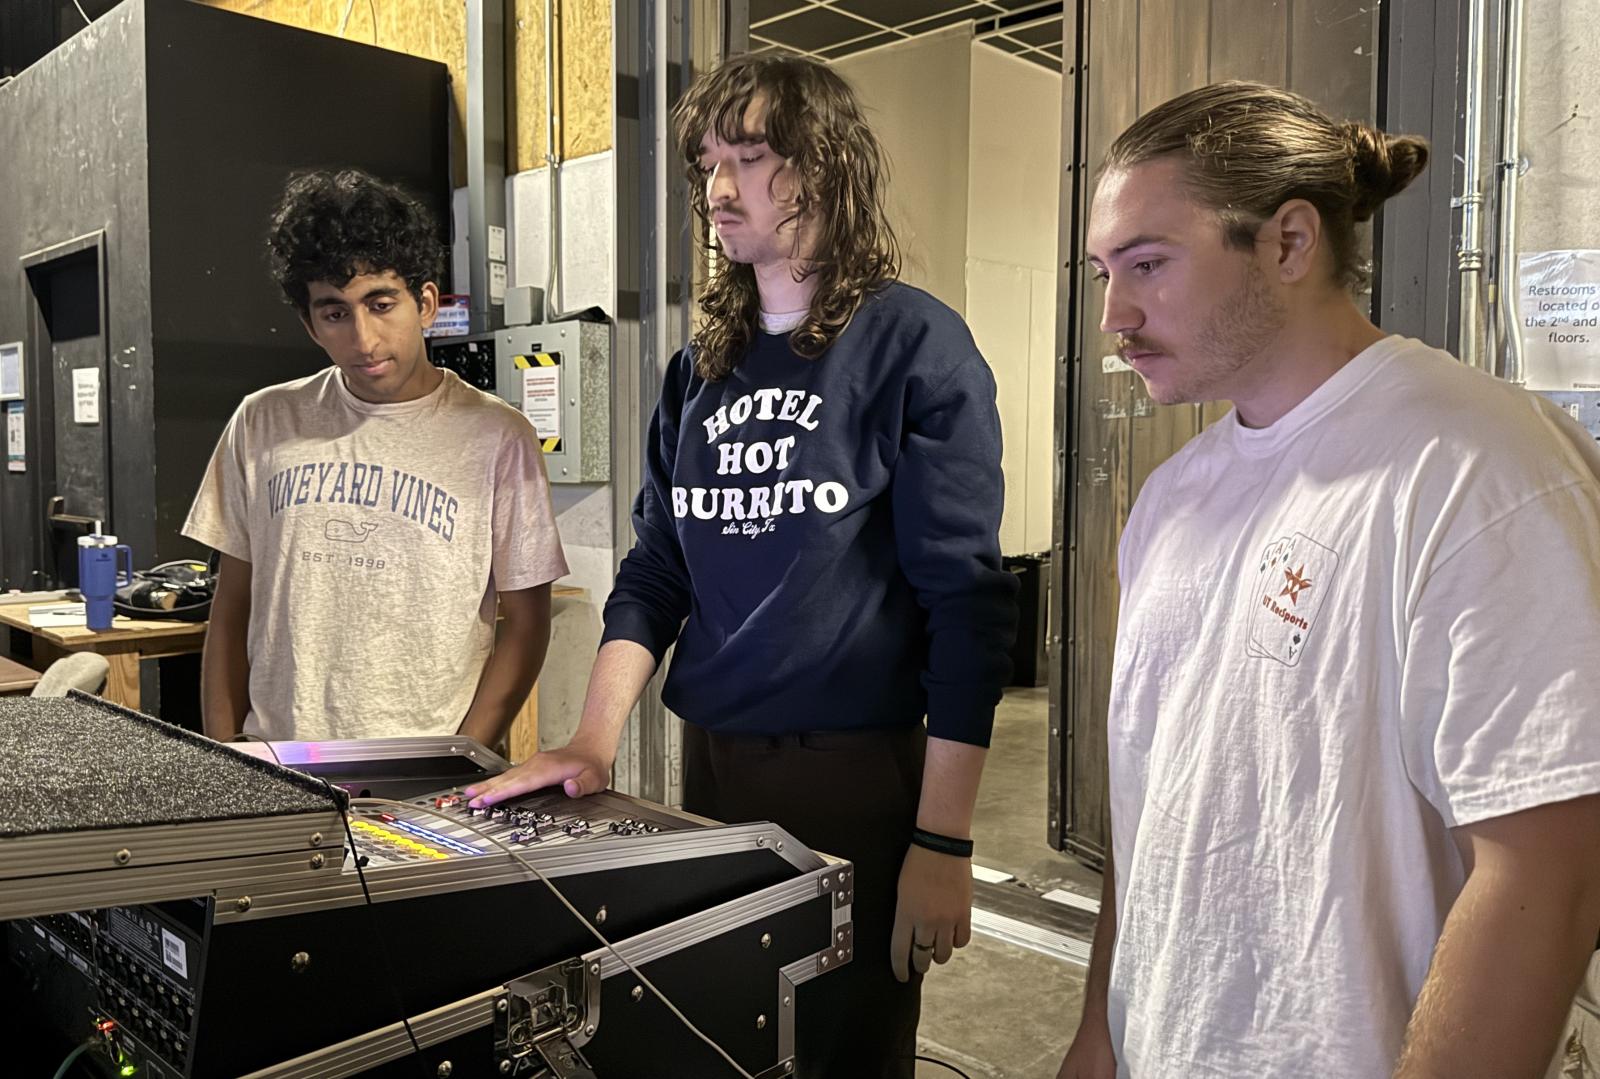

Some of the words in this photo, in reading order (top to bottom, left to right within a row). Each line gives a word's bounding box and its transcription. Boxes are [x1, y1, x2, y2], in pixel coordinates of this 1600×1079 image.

[1528, 285, 1596, 296] Restrooms
[1538, 300, 1588, 311] located
[1525, 316, 1546, 328] the
[1572, 315, 1598, 327] and
[1548, 331, 1590, 343] floors.
[702, 387, 823, 444] HOTEL
[716, 435, 796, 475] HOT
[268, 462, 383, 519] VINEYARD
[391, 469, 459, 543] VINES
[672, 479, 849, 520] BURRITO
[348, 556, 386, 569] 1998
[1262, 594, 1272, 608] UT
[1270, 600, 1309, 630] RecSports
